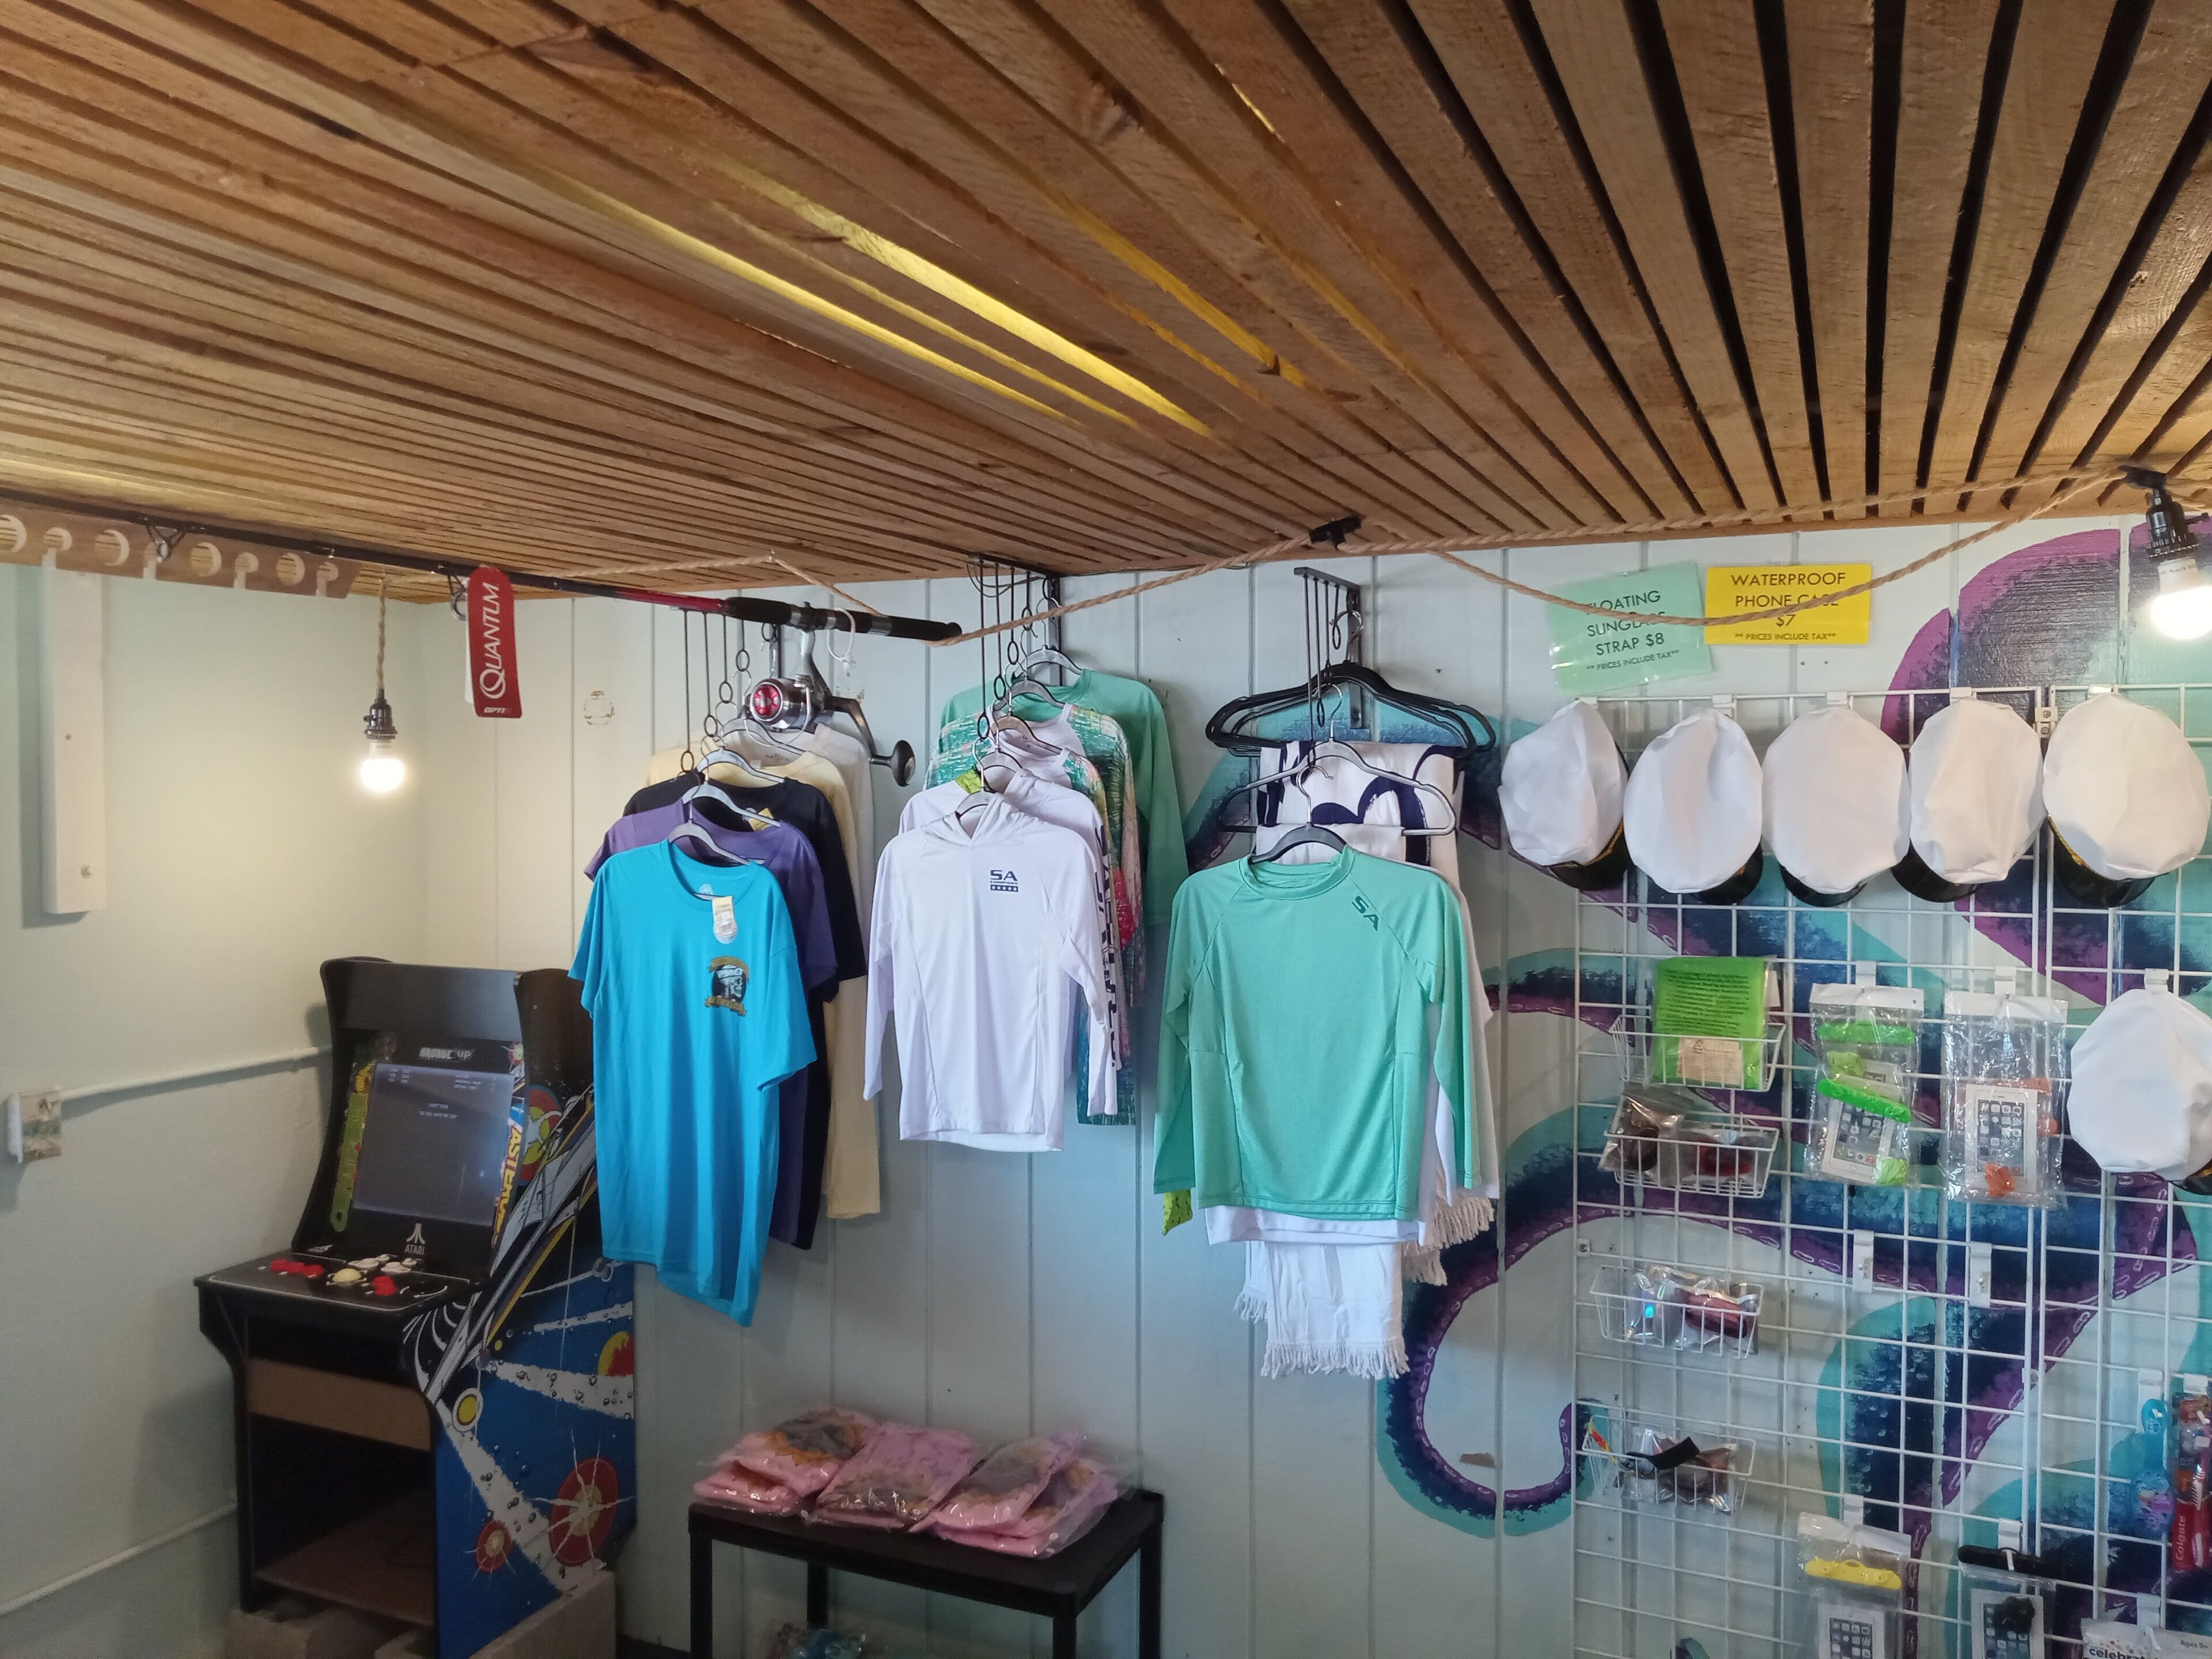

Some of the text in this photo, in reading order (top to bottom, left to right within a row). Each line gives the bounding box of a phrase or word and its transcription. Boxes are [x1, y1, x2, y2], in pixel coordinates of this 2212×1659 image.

[1730, 573, 1846, 586] WATERPROOF
[1586, 590, 1661, 615] OATING
[1735, 594, 1792, 607] PHONE
[1587, 611, 1665, 637] SUNGL
[1776, 614, 1796, 628] $7
[479, 581, 506, 699] QUANTUM
[1596, 632, 1664, 656] STRAP $8
[1597, 660, 1622, 671] PRICES
[1623, 654, 1656, 666] INCLUDE
[990, 870, 1018, 881] SA
[1351, 896, 1379, 932] SA
[404, 1244, 425, 1255] ATARI
[2175, 1516, 2187, 1561] Colgate
